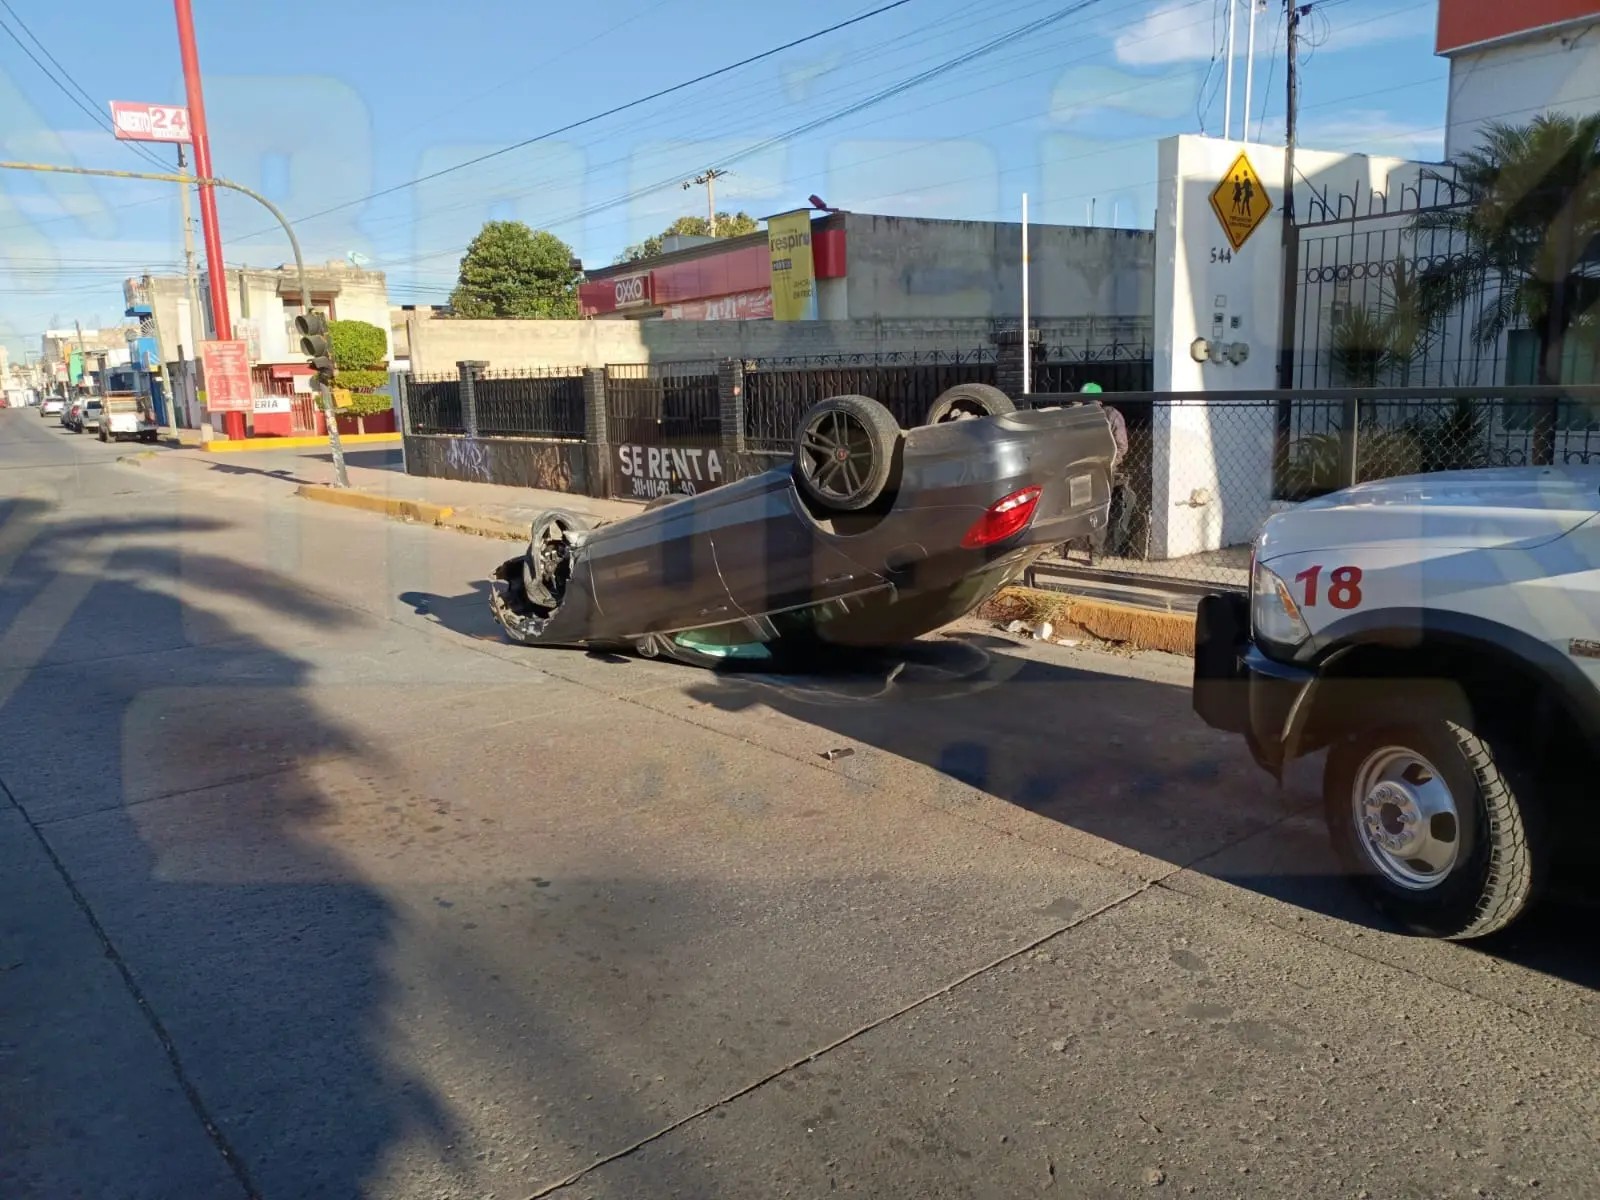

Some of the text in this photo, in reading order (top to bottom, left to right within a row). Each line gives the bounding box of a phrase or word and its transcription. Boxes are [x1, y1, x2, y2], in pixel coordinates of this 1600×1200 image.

[152, 109, 185, 129] 24
[1209, 247, 1232, 264] 544
[615, 277, 643, 304] OXXO
[619, 445, 722, 482] SE RENTA
[1294, 564, 1363, 610] 18
